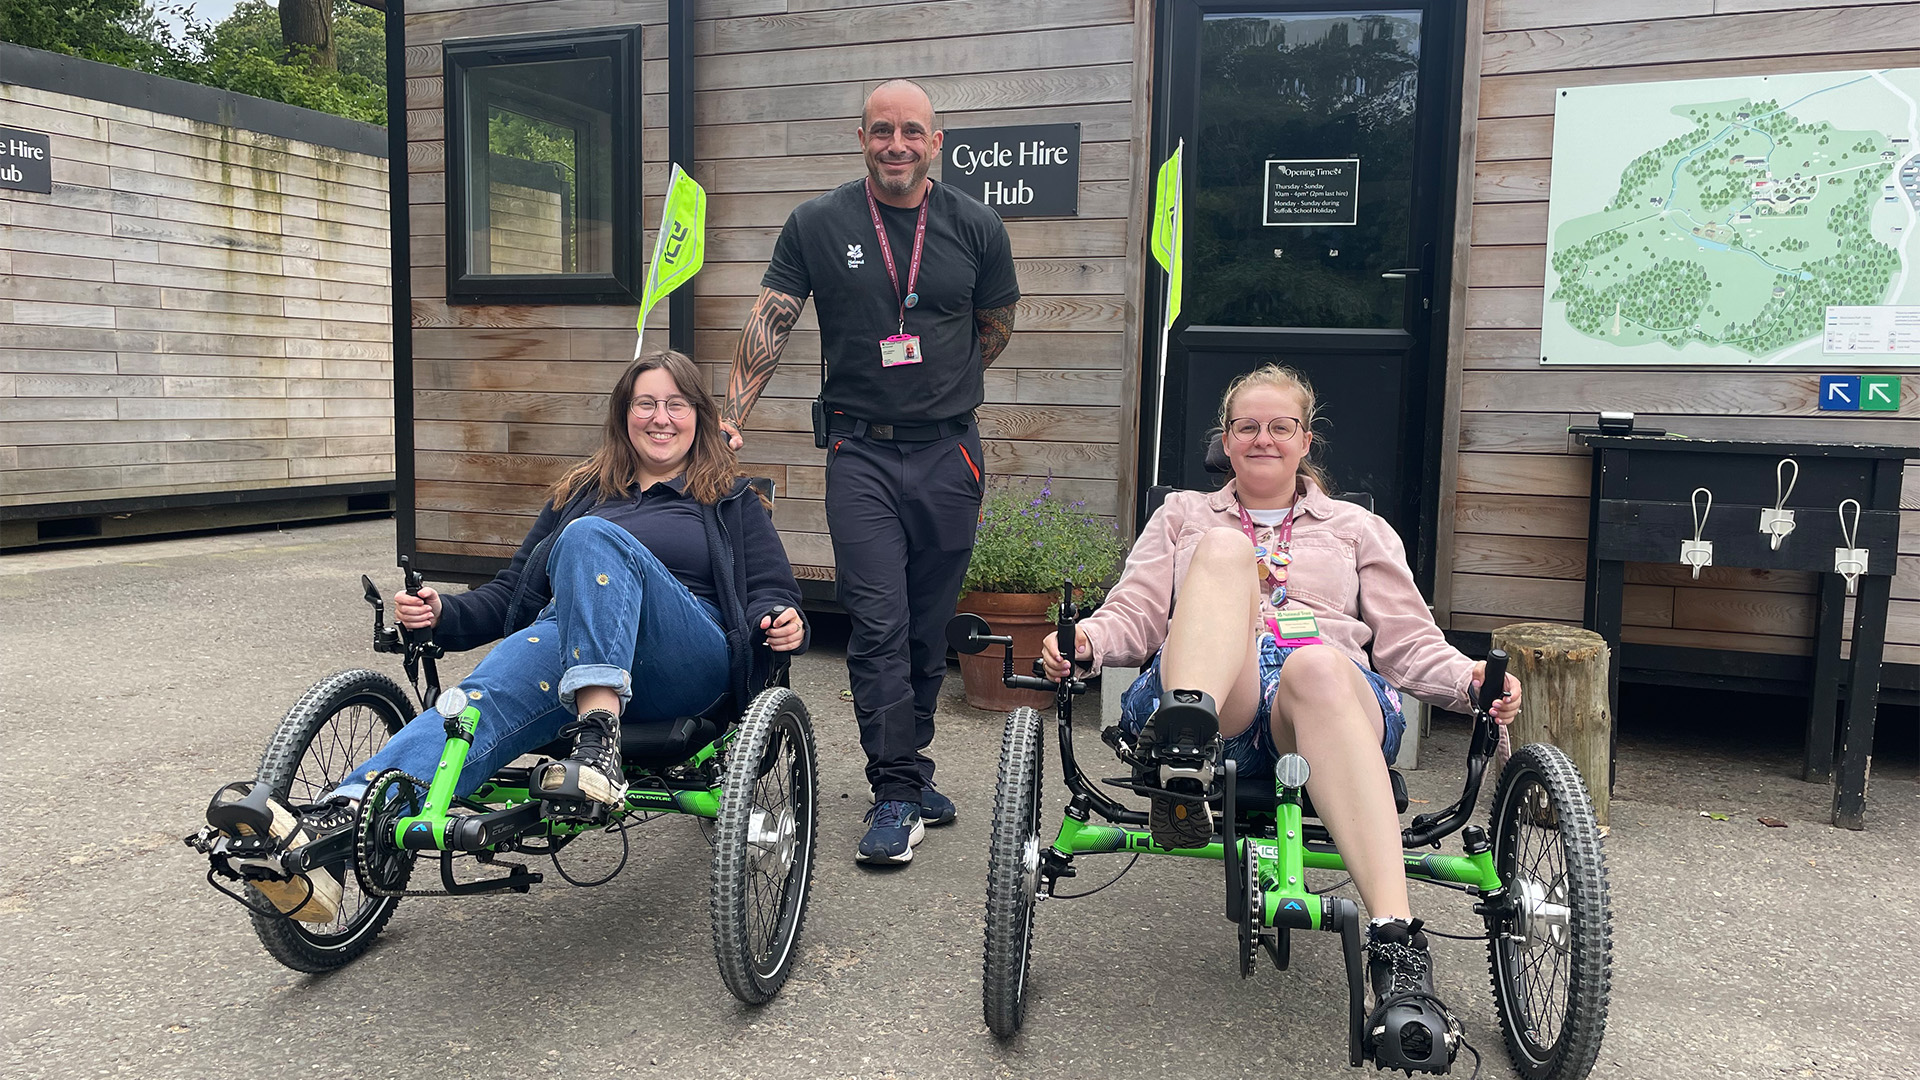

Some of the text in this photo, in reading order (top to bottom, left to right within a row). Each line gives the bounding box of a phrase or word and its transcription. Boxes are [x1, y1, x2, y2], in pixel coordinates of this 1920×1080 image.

[10, 139, 44, 161] Hire
[952, 140, 1068, 175] Cycle Hire
[0, 164, 23, 182] ub
[1285, 167, 1337, 177] Opening Times
[984, 179, 1034, 205] Hub
[664, 220, 689, 265] ICE
[628, 793, 672, 802] ADVENTURE
